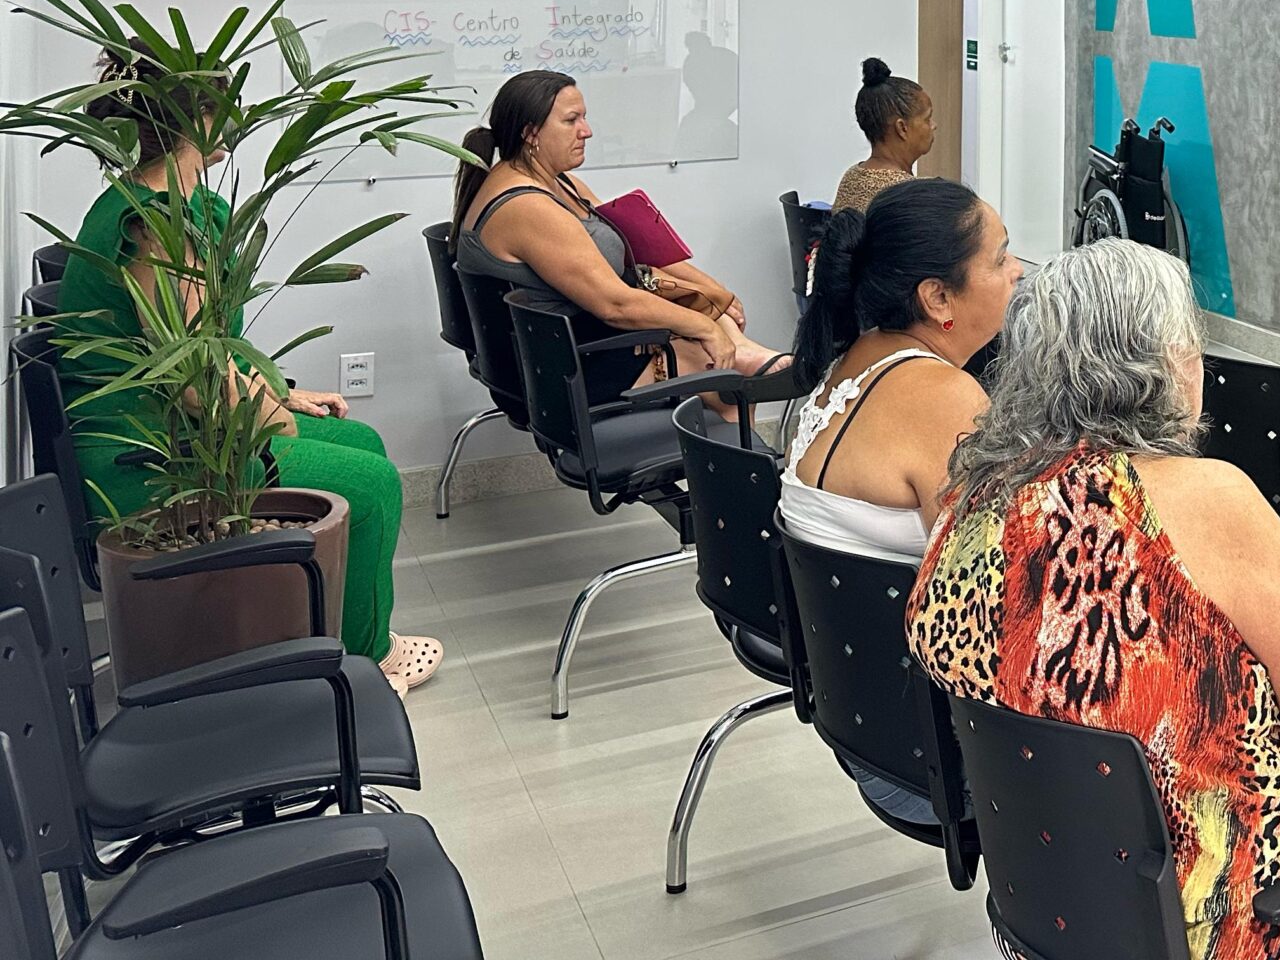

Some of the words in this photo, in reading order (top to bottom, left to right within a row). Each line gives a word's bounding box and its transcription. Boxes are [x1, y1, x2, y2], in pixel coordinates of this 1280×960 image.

[453, 8, 519, 32] Centro
[544, 6, 644, 42] Integrado
[504, 47, 521, 61] de
[536, 39, 600, 60] Saúde
